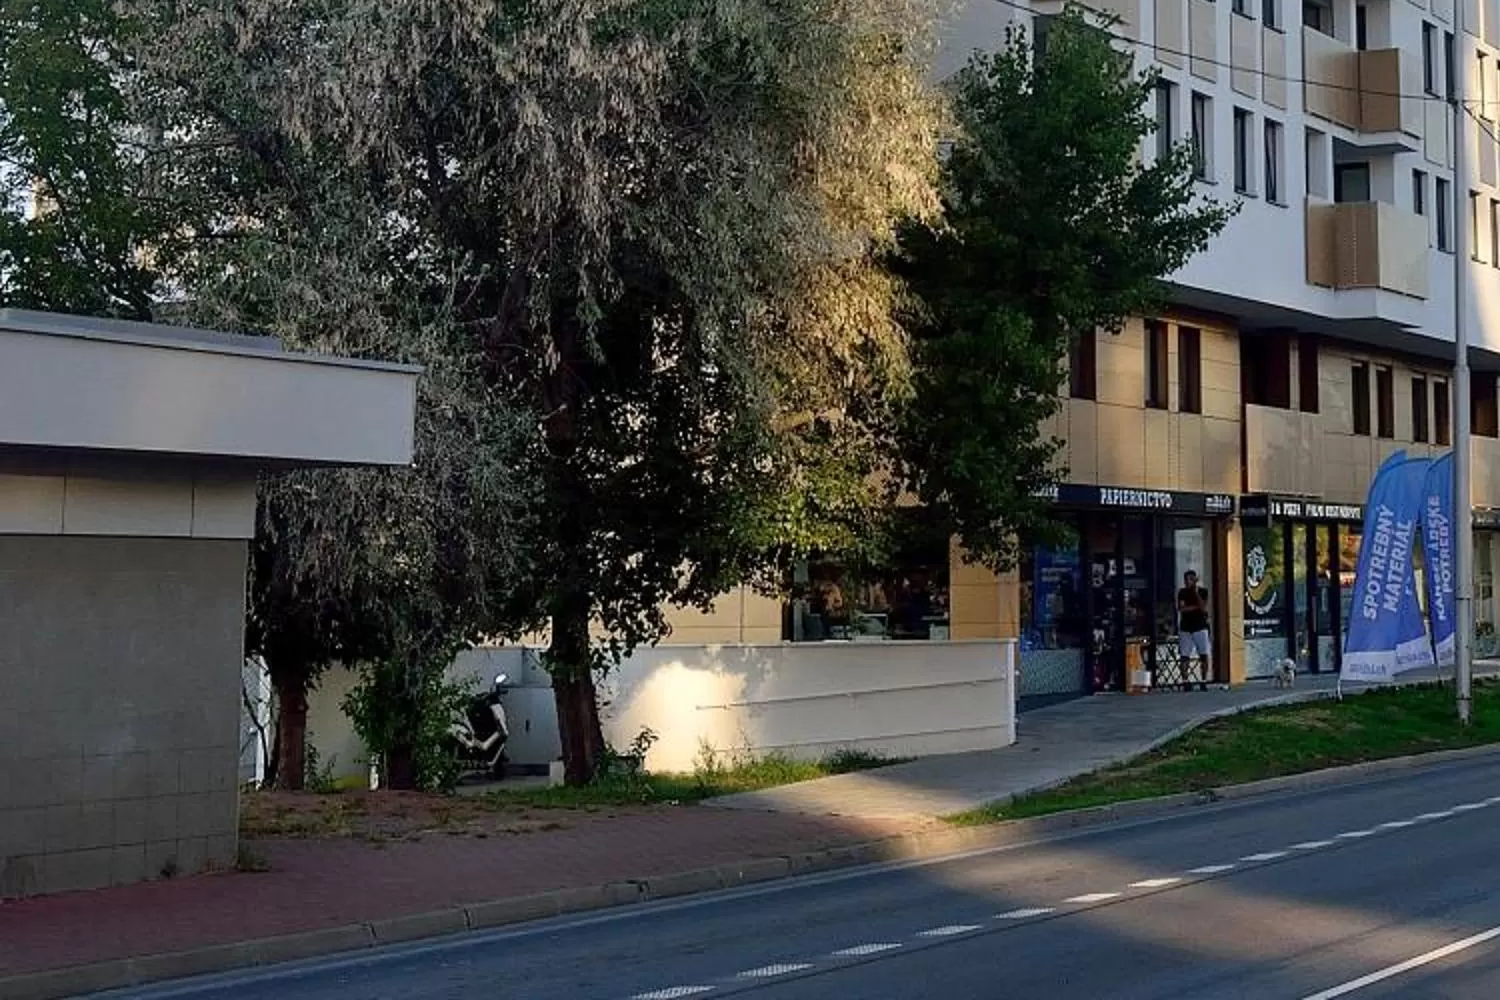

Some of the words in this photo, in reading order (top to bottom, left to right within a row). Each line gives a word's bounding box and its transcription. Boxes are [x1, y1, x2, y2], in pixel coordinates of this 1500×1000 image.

[1100, 488, 1173, 508] PAPIERNICTVO
[1364, 504, 1395, 620] SPOTREBNÝ
[1439, 514, 1453, 593] POTREBY
